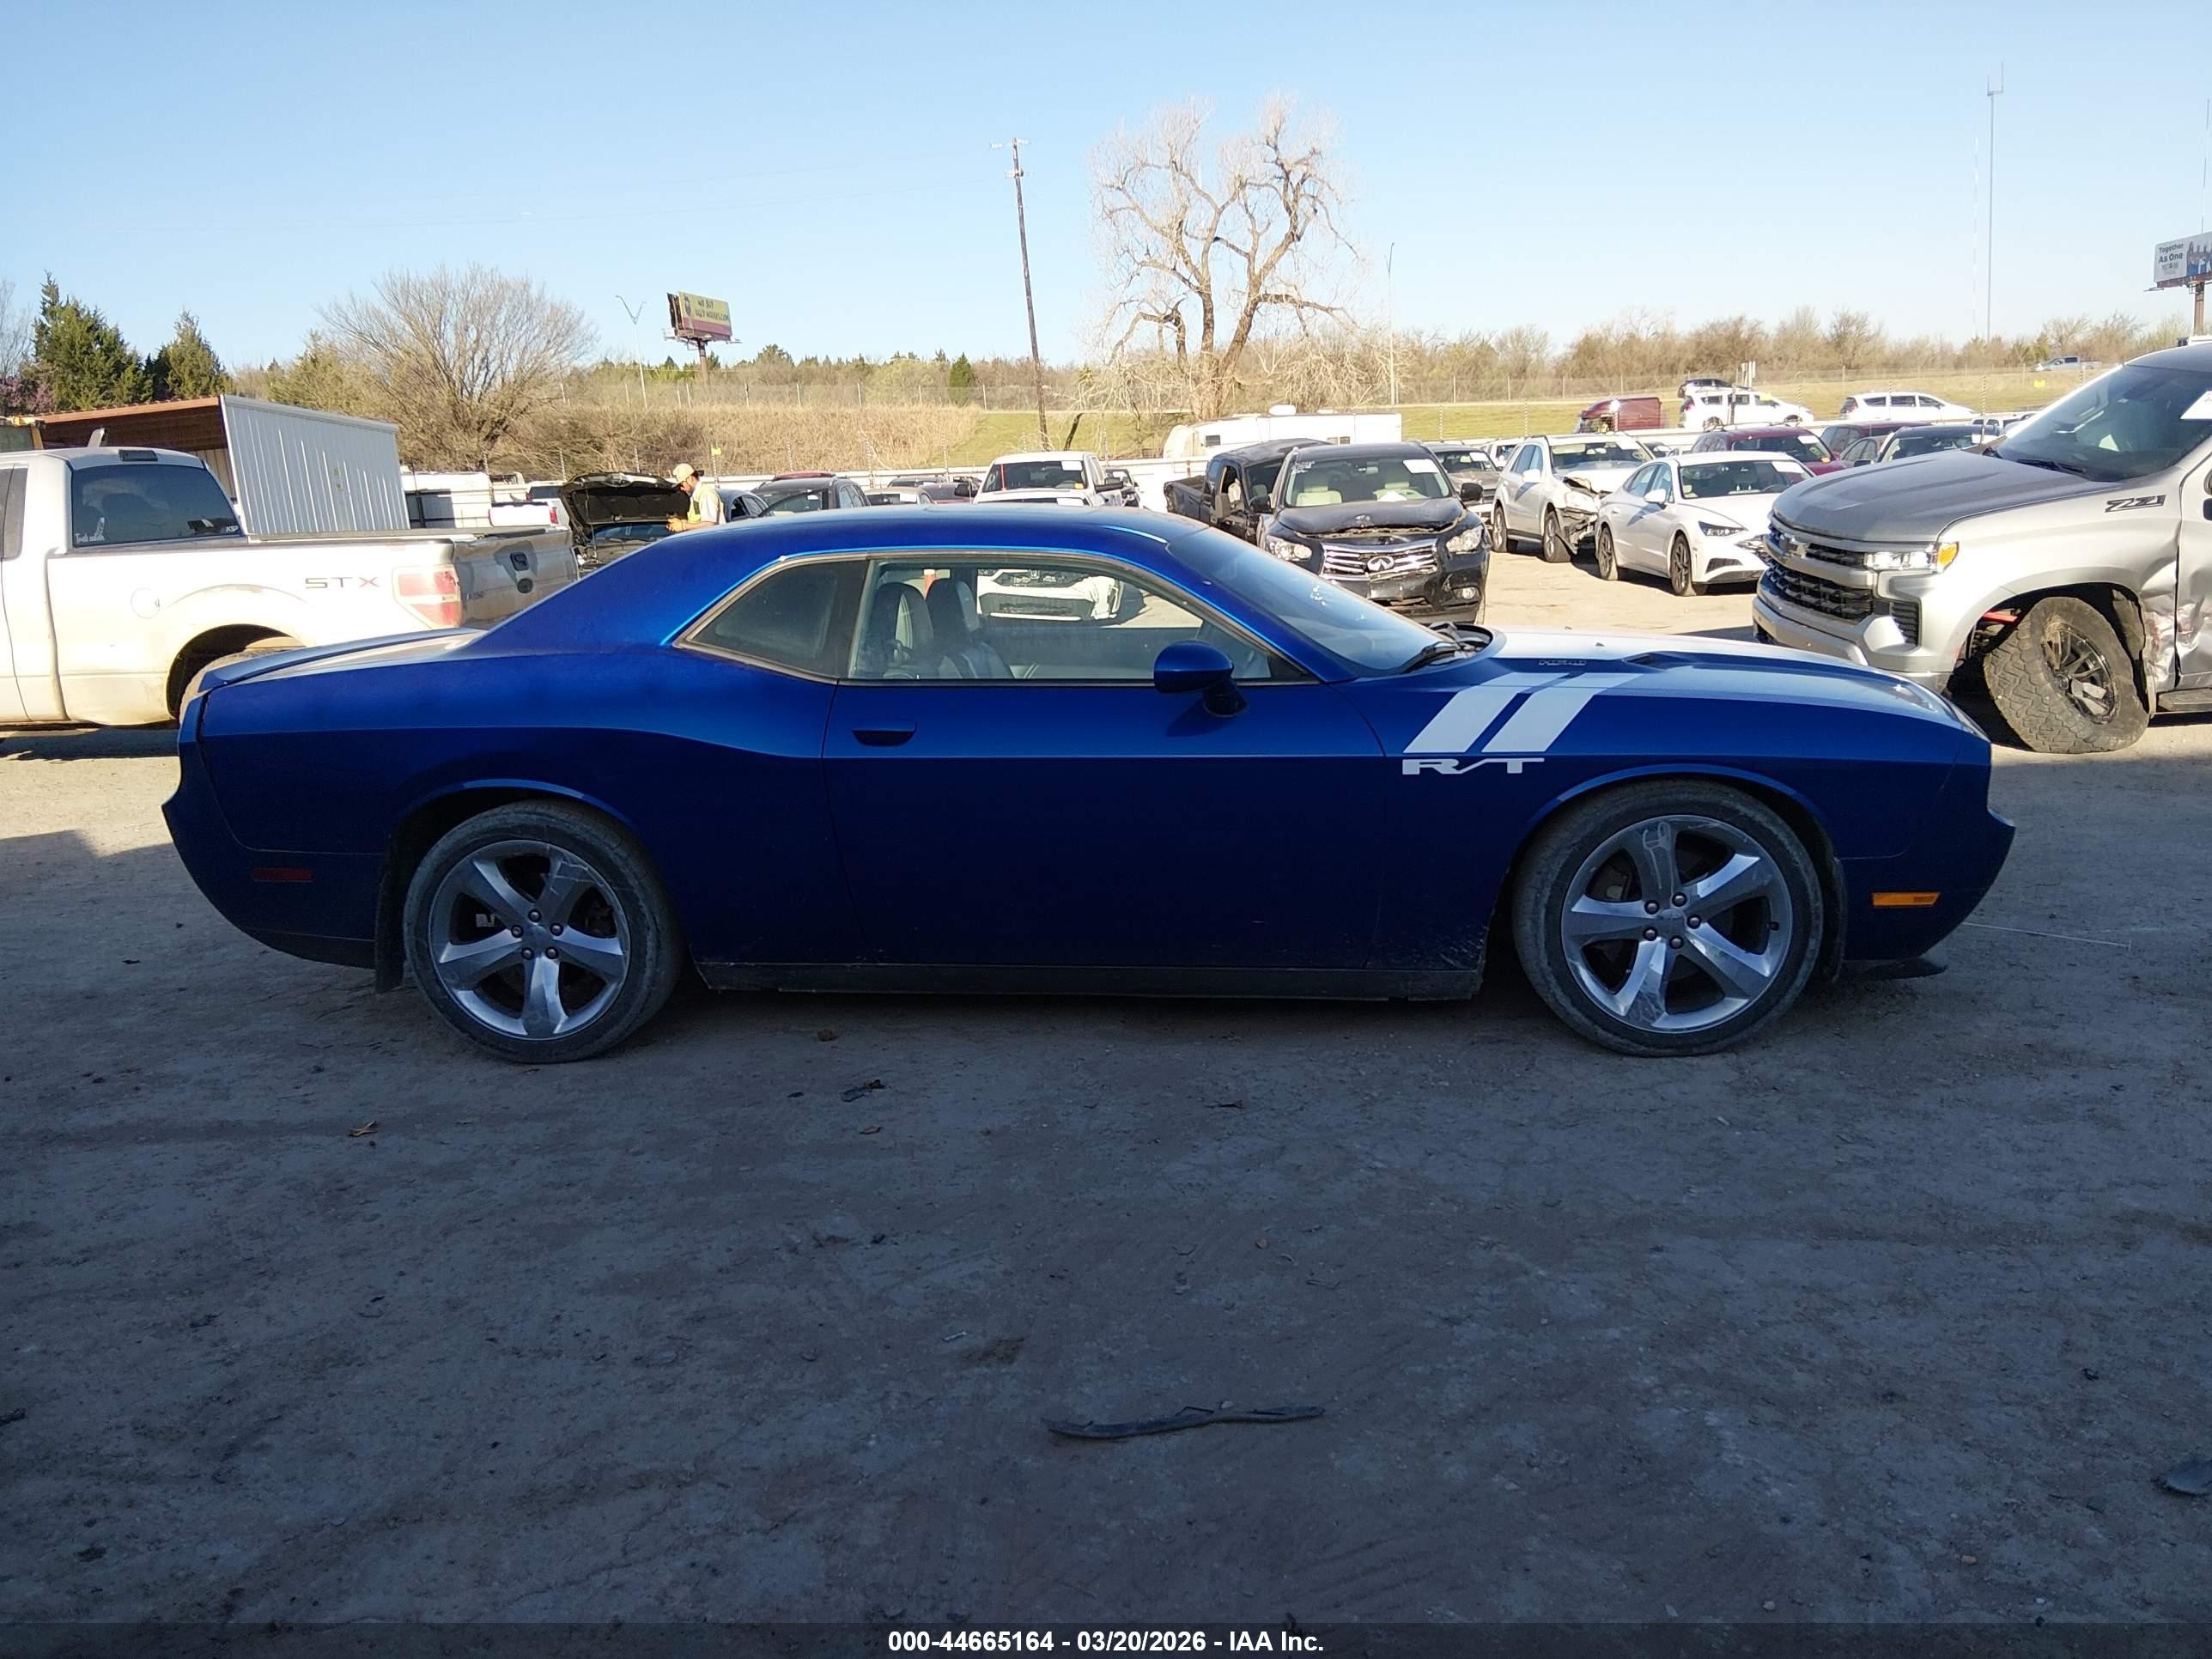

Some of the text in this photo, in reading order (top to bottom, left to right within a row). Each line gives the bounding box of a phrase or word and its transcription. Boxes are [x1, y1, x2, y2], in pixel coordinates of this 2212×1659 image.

[2159, 244, 2184, 253] Together
[2169, 252, 2183, 261] One
[305, 576, 380, 589] STX
[1402, 757, 1545, 775] R/T
